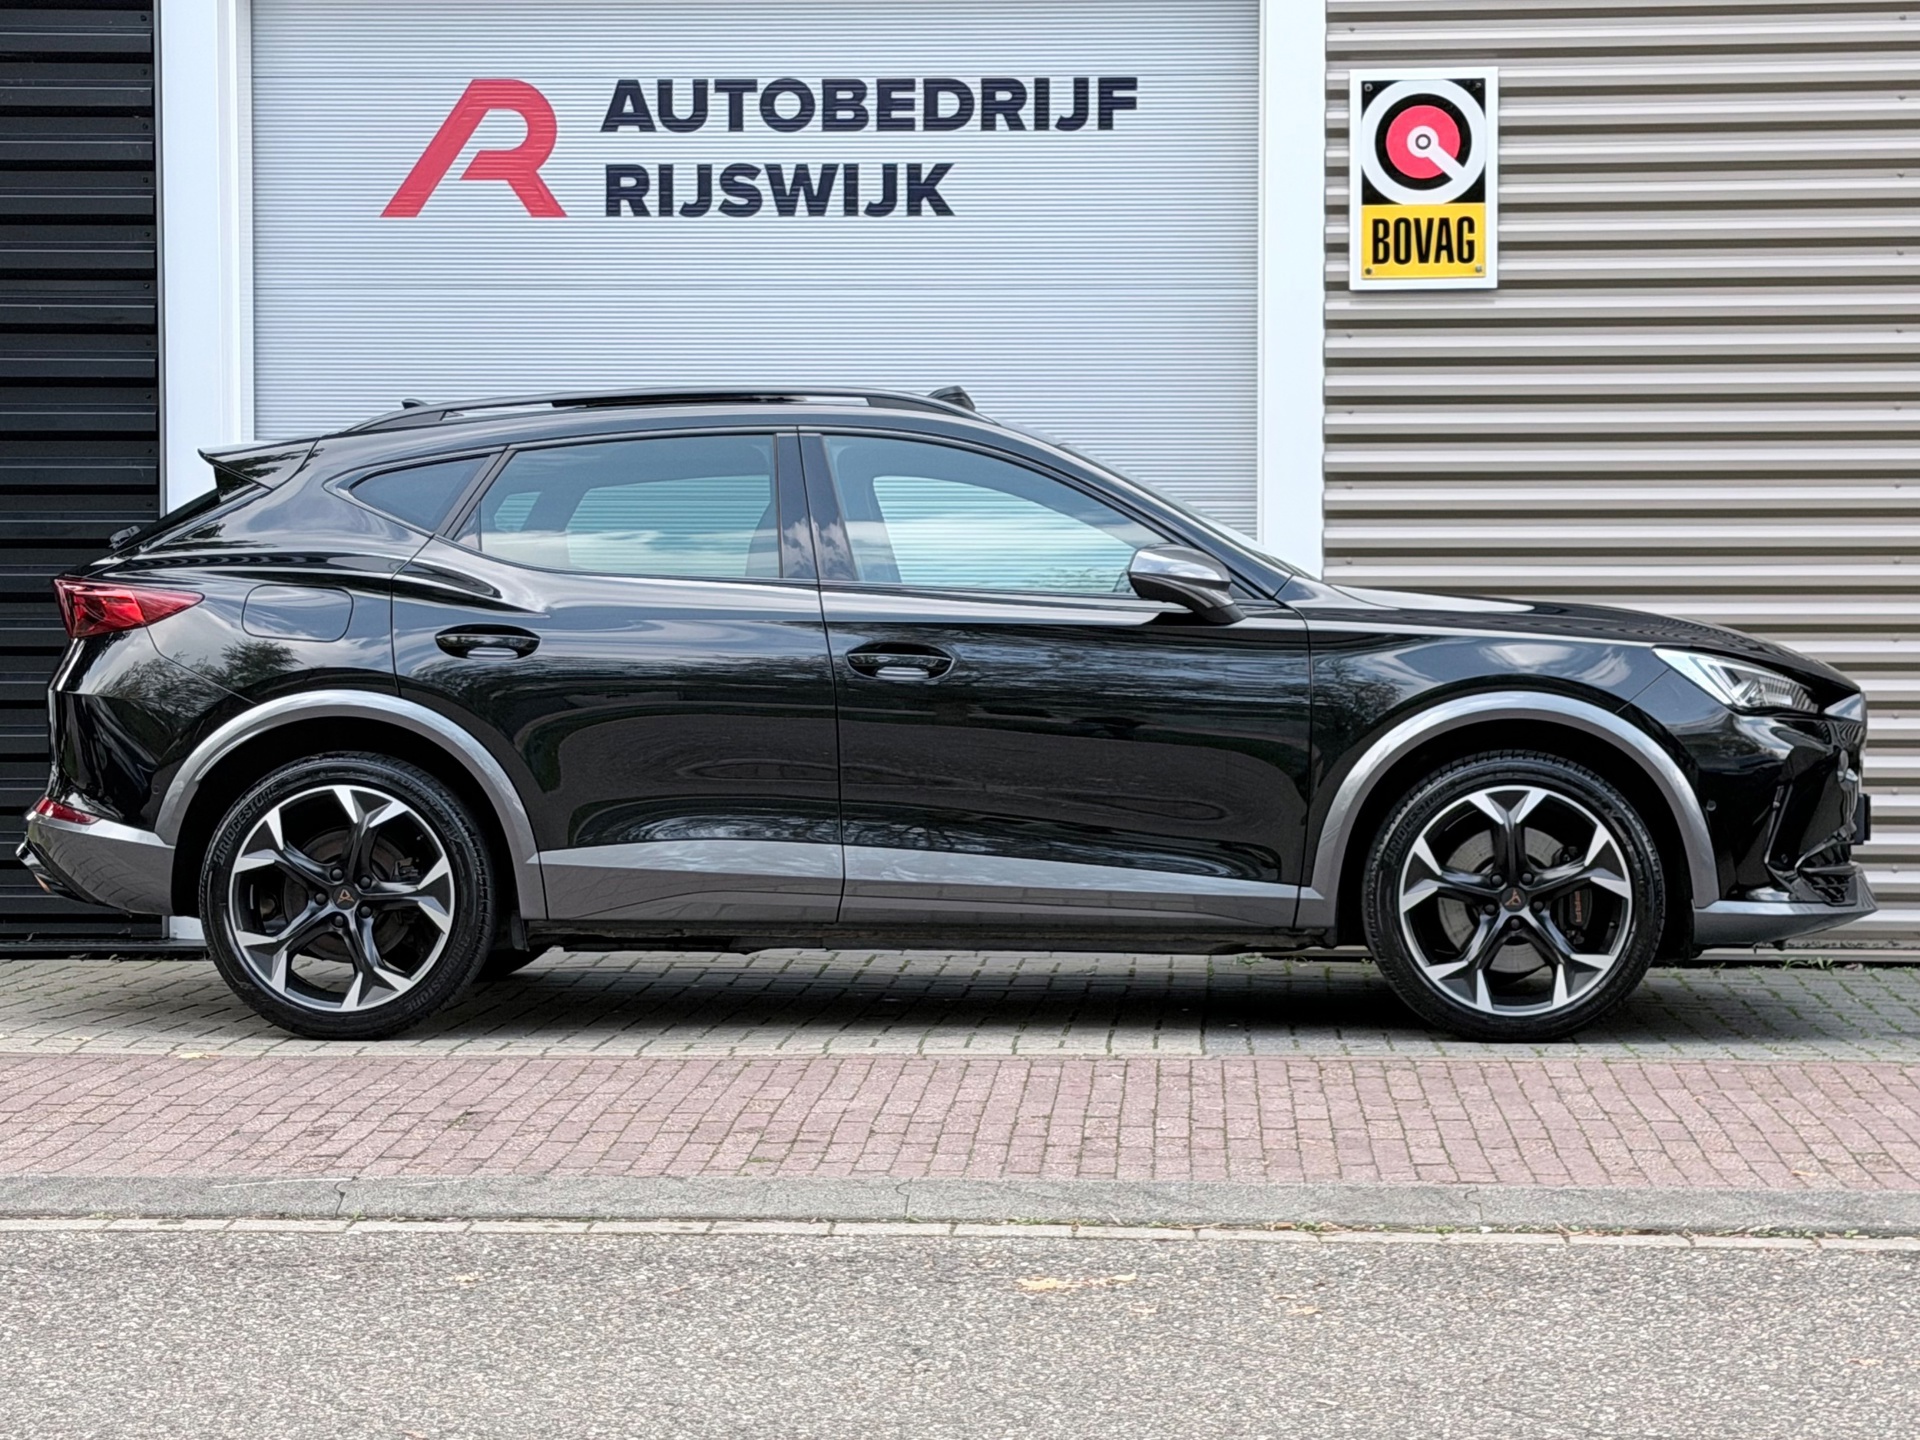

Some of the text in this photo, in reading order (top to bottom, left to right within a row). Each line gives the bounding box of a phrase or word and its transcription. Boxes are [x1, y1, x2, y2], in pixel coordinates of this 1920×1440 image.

[600, 77, 1138, 132] AUTOBEDRIJF
[606, 163, 954, 218] RIJSWIJK
[1372, 217, 1475, 265] BOVAG
[213, 784, 280, 866] BRIDGESTONE
